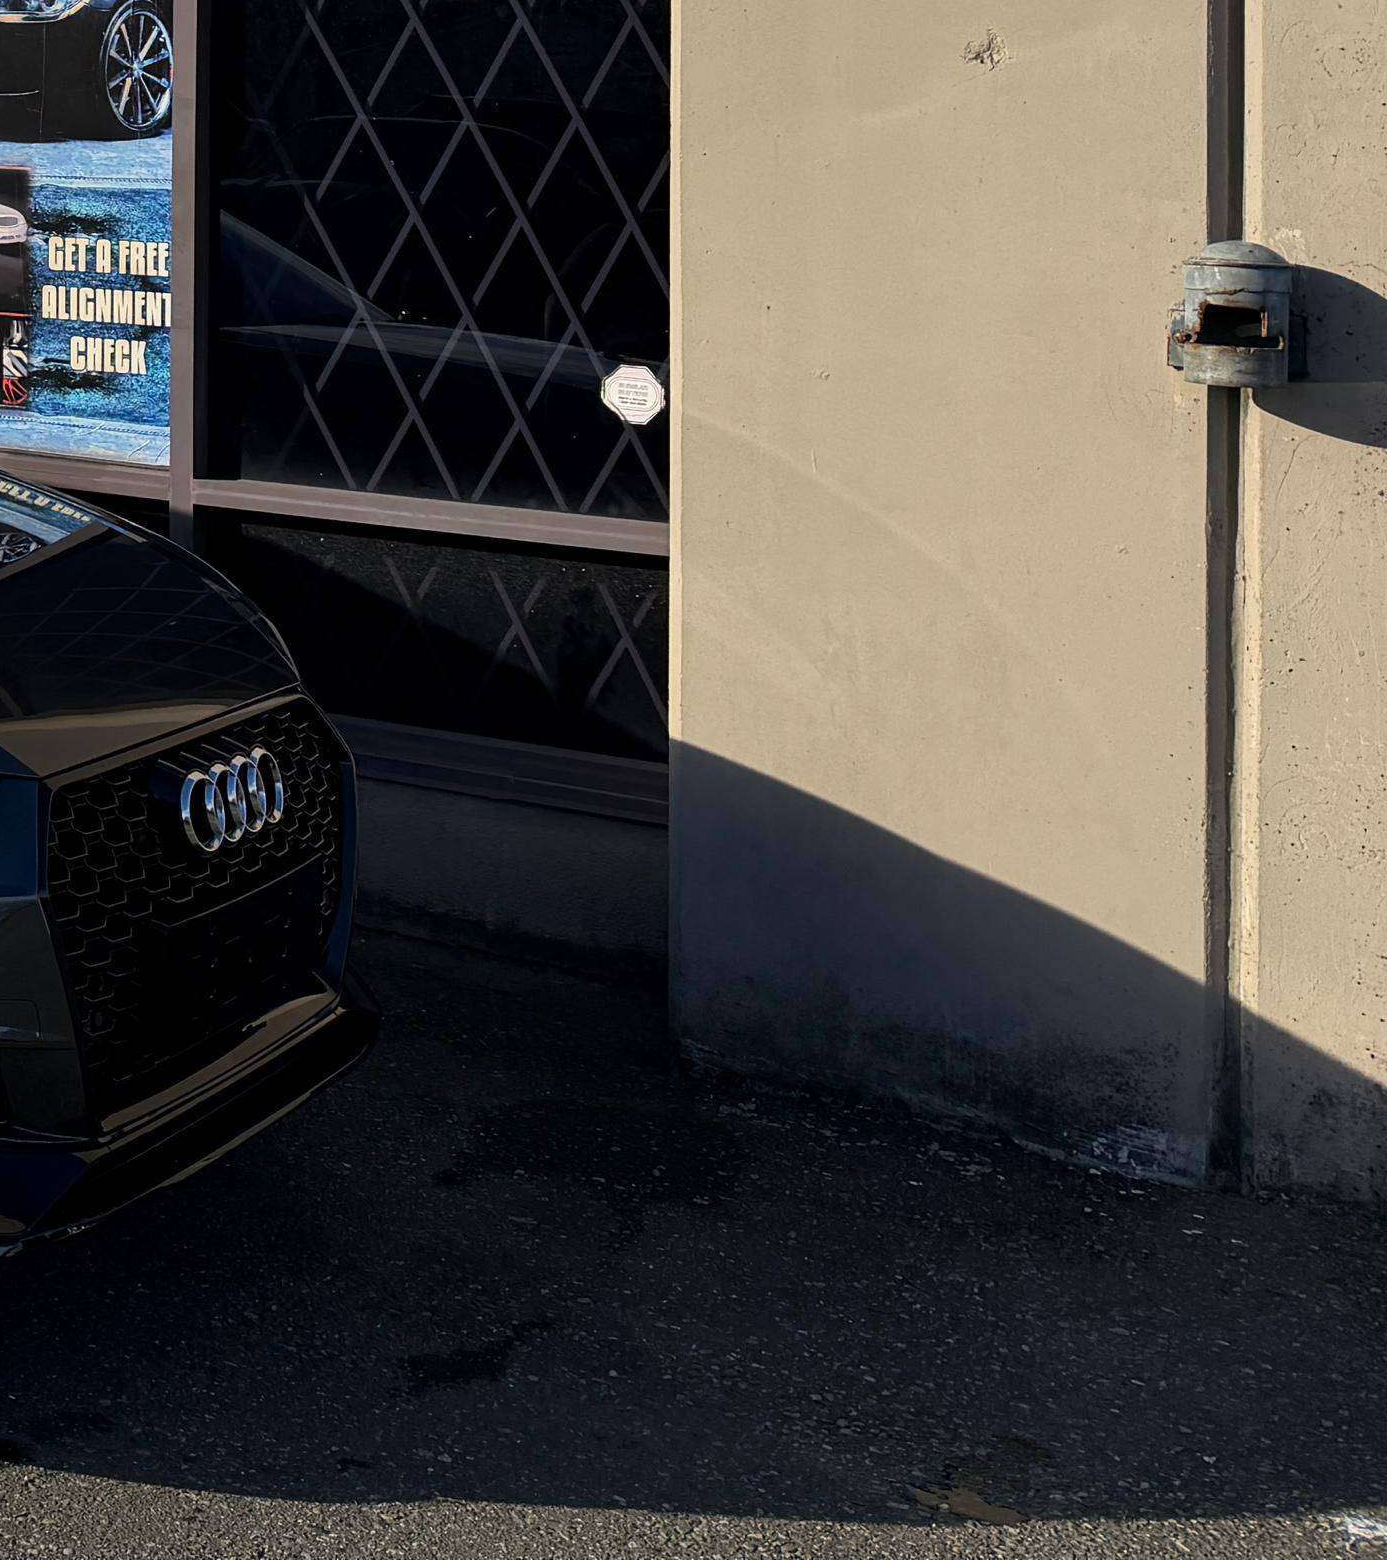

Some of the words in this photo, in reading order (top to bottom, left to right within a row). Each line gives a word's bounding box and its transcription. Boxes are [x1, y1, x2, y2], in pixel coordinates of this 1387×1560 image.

[48, 236, 90, 272] GET
[95, 238, 113, 274] A
[118, 239, 170, 278] FREE
[70, 336, 148, 375] CHECK
